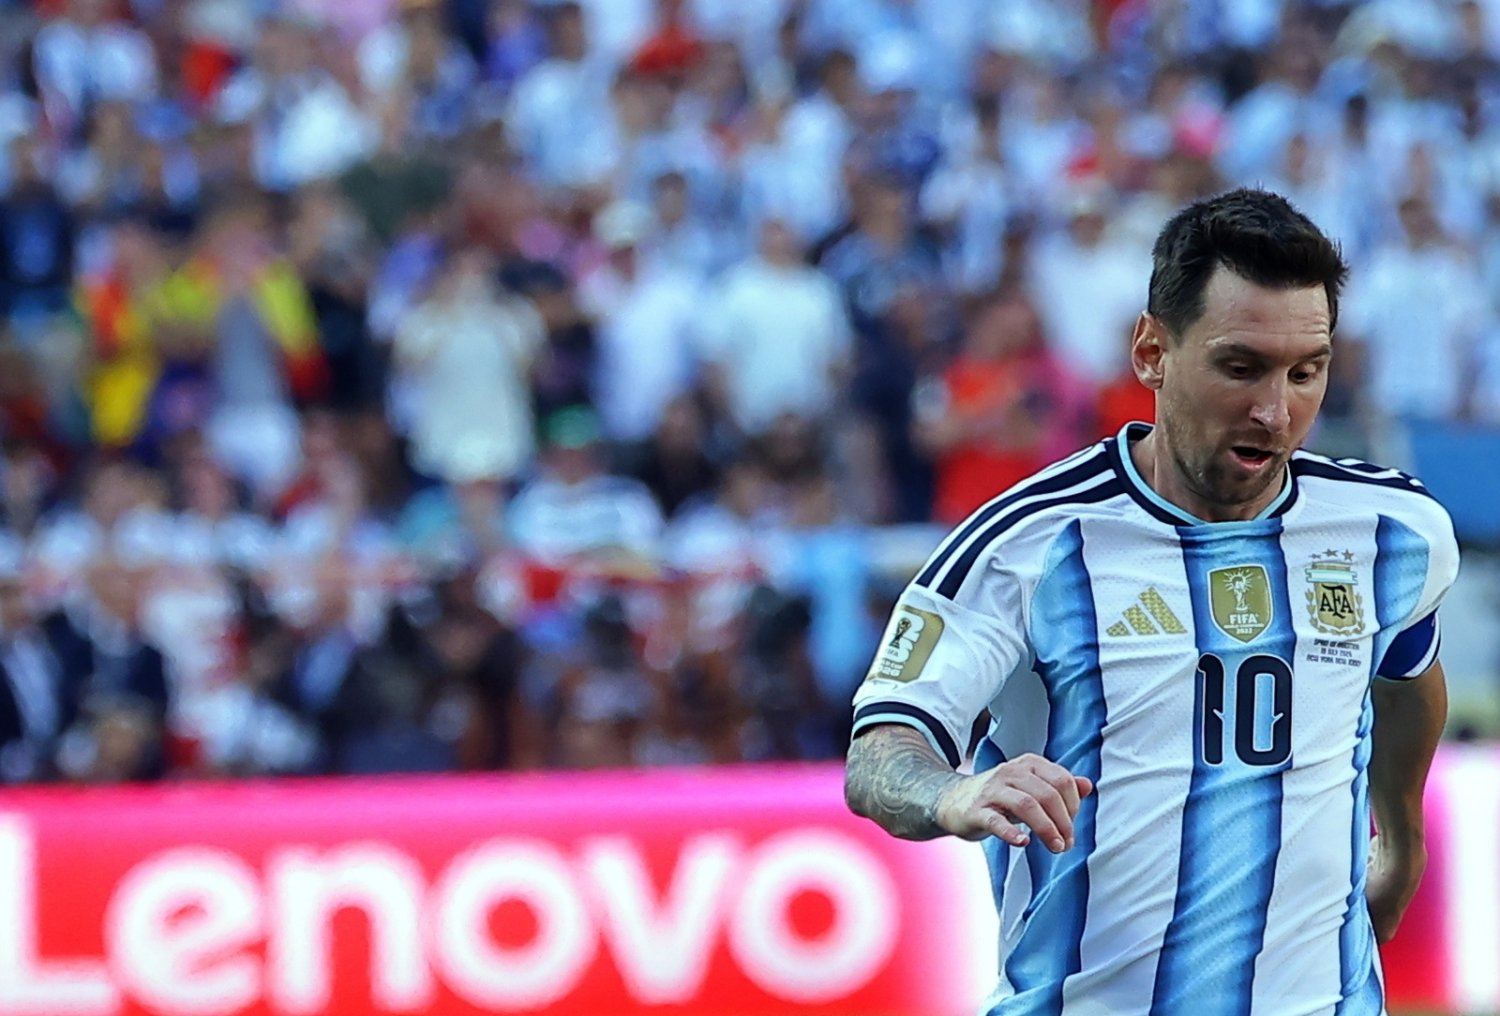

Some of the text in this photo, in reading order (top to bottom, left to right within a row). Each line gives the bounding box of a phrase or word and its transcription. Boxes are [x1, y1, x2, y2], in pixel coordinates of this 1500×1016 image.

[1229, 613, 1258, 625] FIFA
[1320, 584, 1353, 619] AFA
[1197, 652, 1294, 767] 10
